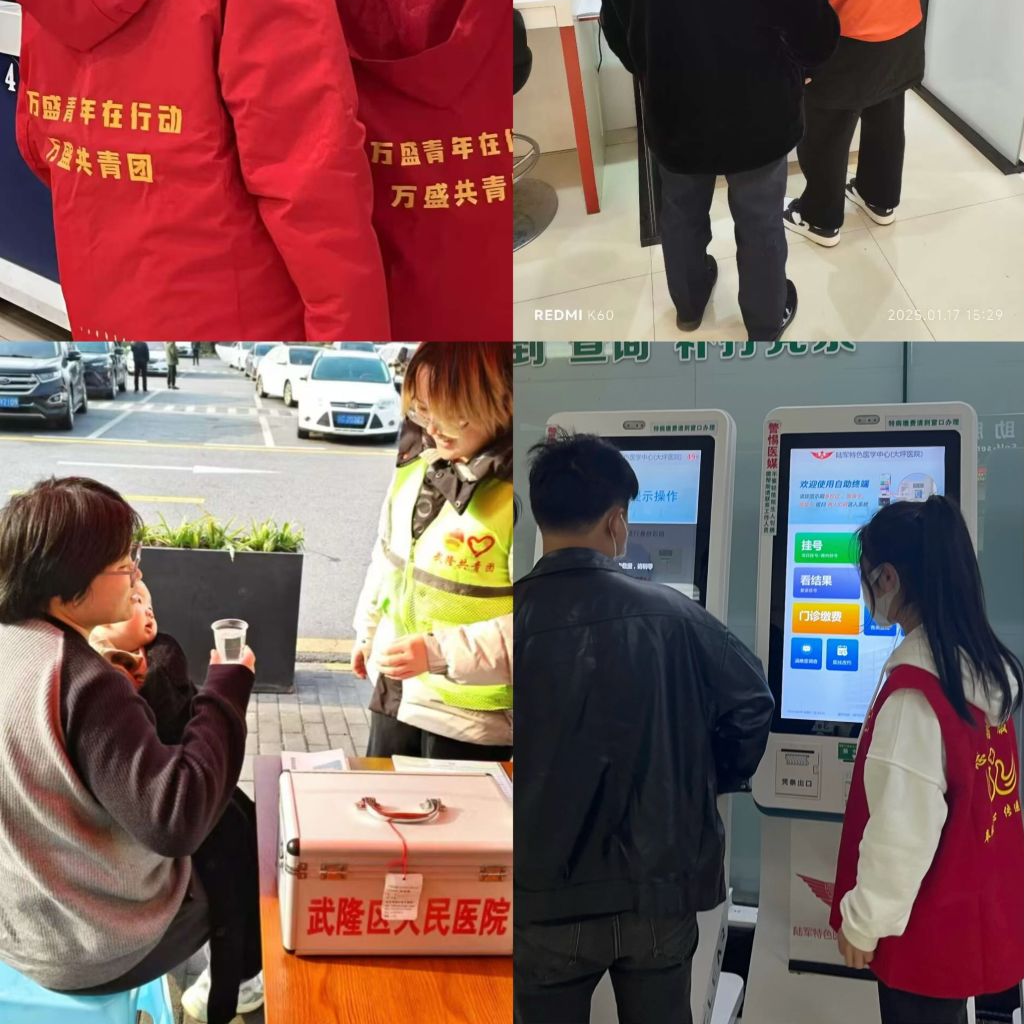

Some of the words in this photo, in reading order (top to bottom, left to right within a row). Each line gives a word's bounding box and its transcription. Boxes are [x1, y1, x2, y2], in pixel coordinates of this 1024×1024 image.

[26, 90, 183, 135] 万盛青年在行动
[45, 137, 154, 183] 万盛共青团
[390, 174, 513, 209] 万盛共青
[799, 479, 870, 490] 欢迎使用自助终端
[801, 539, 823, 552] 挂号
[799, 574, 833, 587] 看结果
[799, 610, 842, 623] 门诊缴费
[781, 777, 813, 788] 凭条出口
